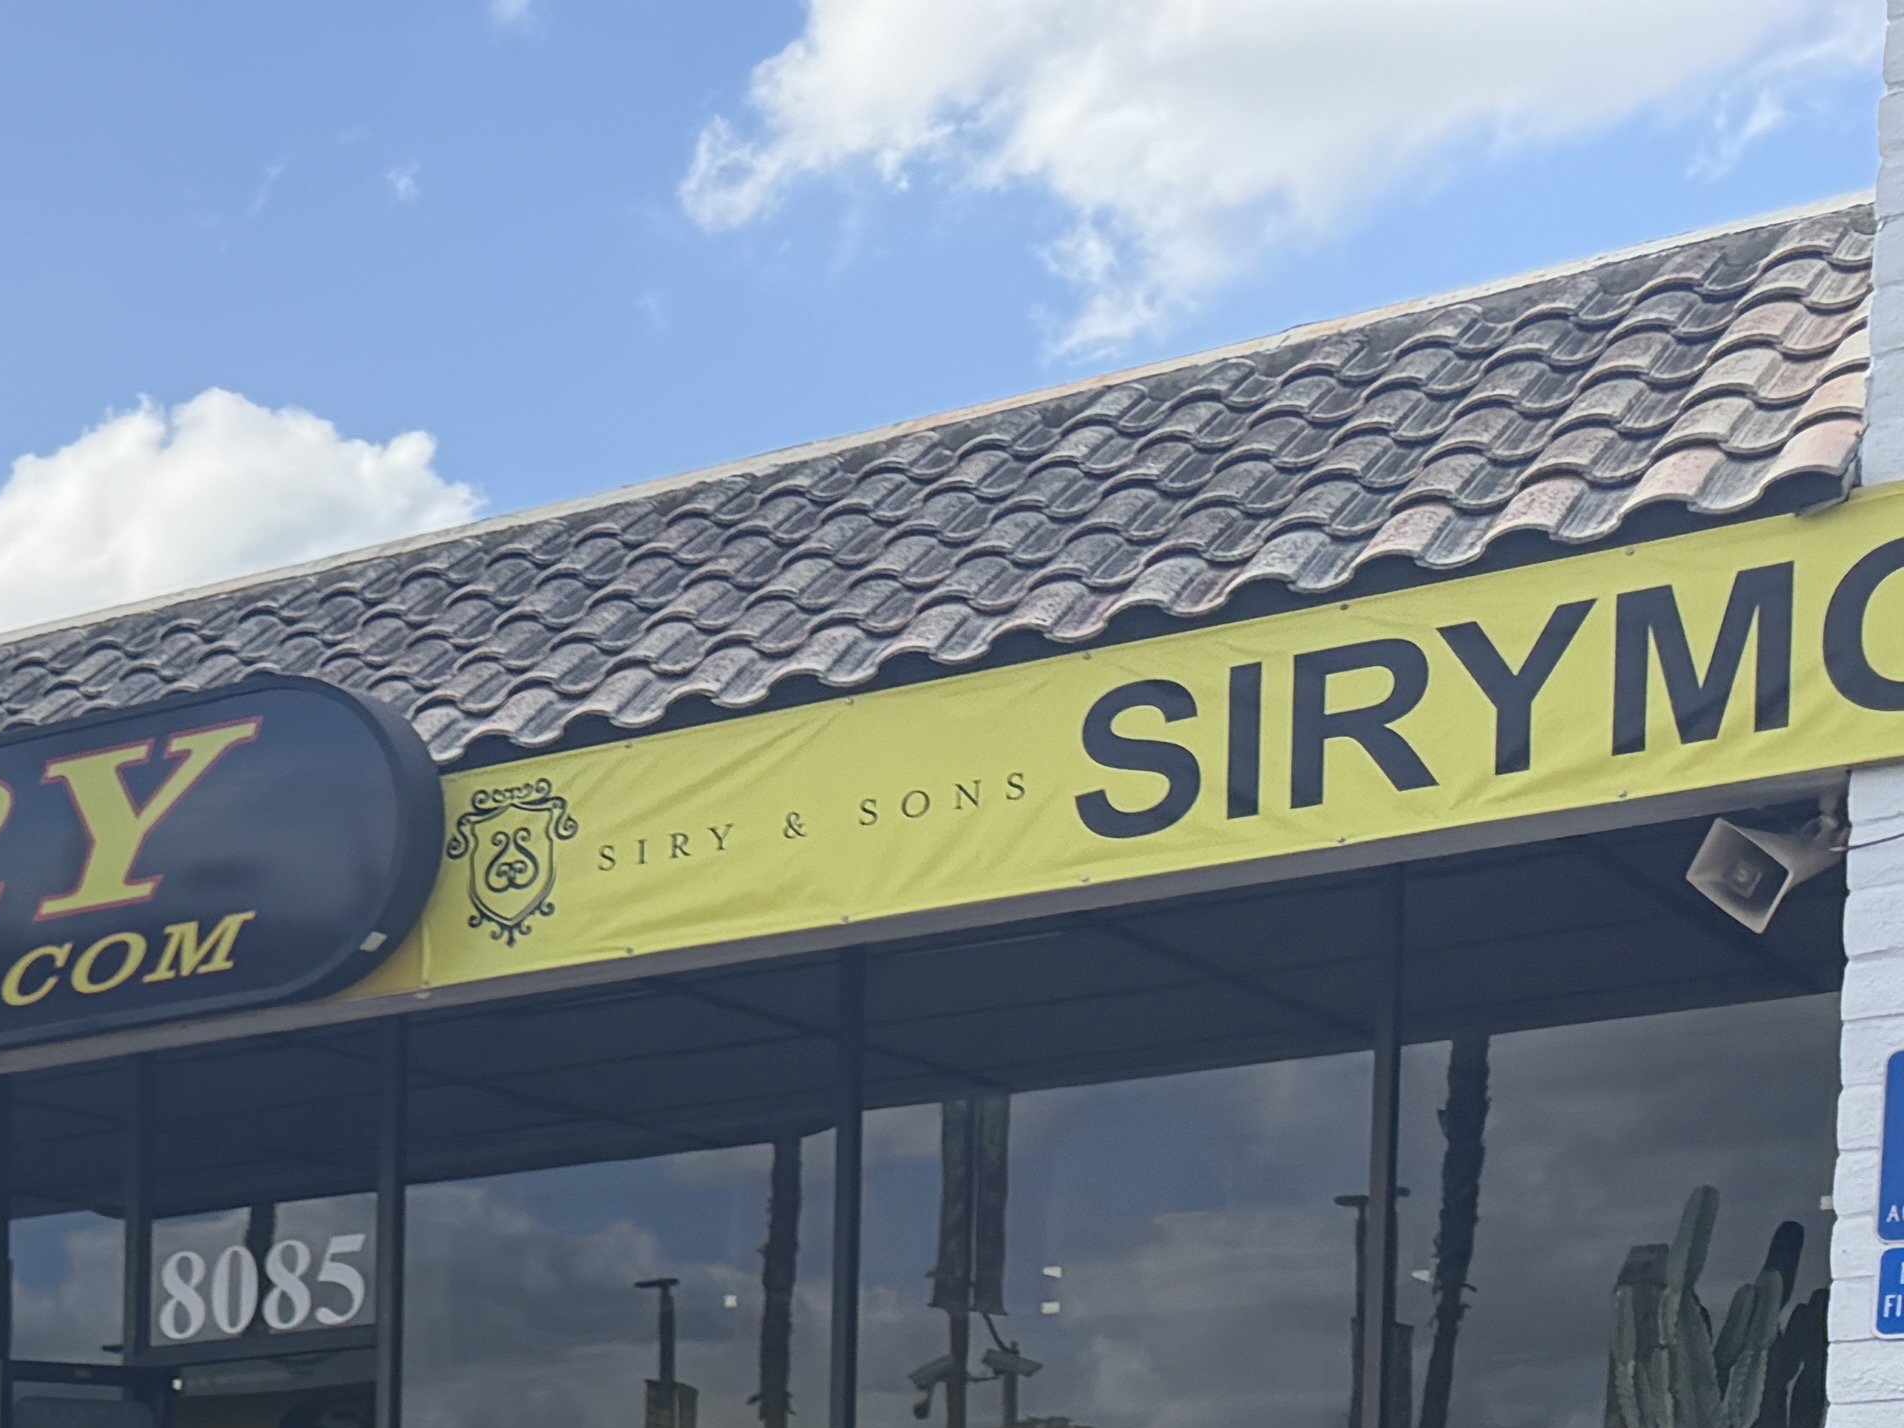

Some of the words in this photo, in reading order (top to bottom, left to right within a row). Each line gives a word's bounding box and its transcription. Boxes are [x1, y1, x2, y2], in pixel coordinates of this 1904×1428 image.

[597, 824, 735, 872] SIRY
[782, 812, 807, 839] &
[858, 771, 1028, 826] SONS
[1887, 1205, 1904, 1222] A
[159, 1233, 366, 1340] 8085
